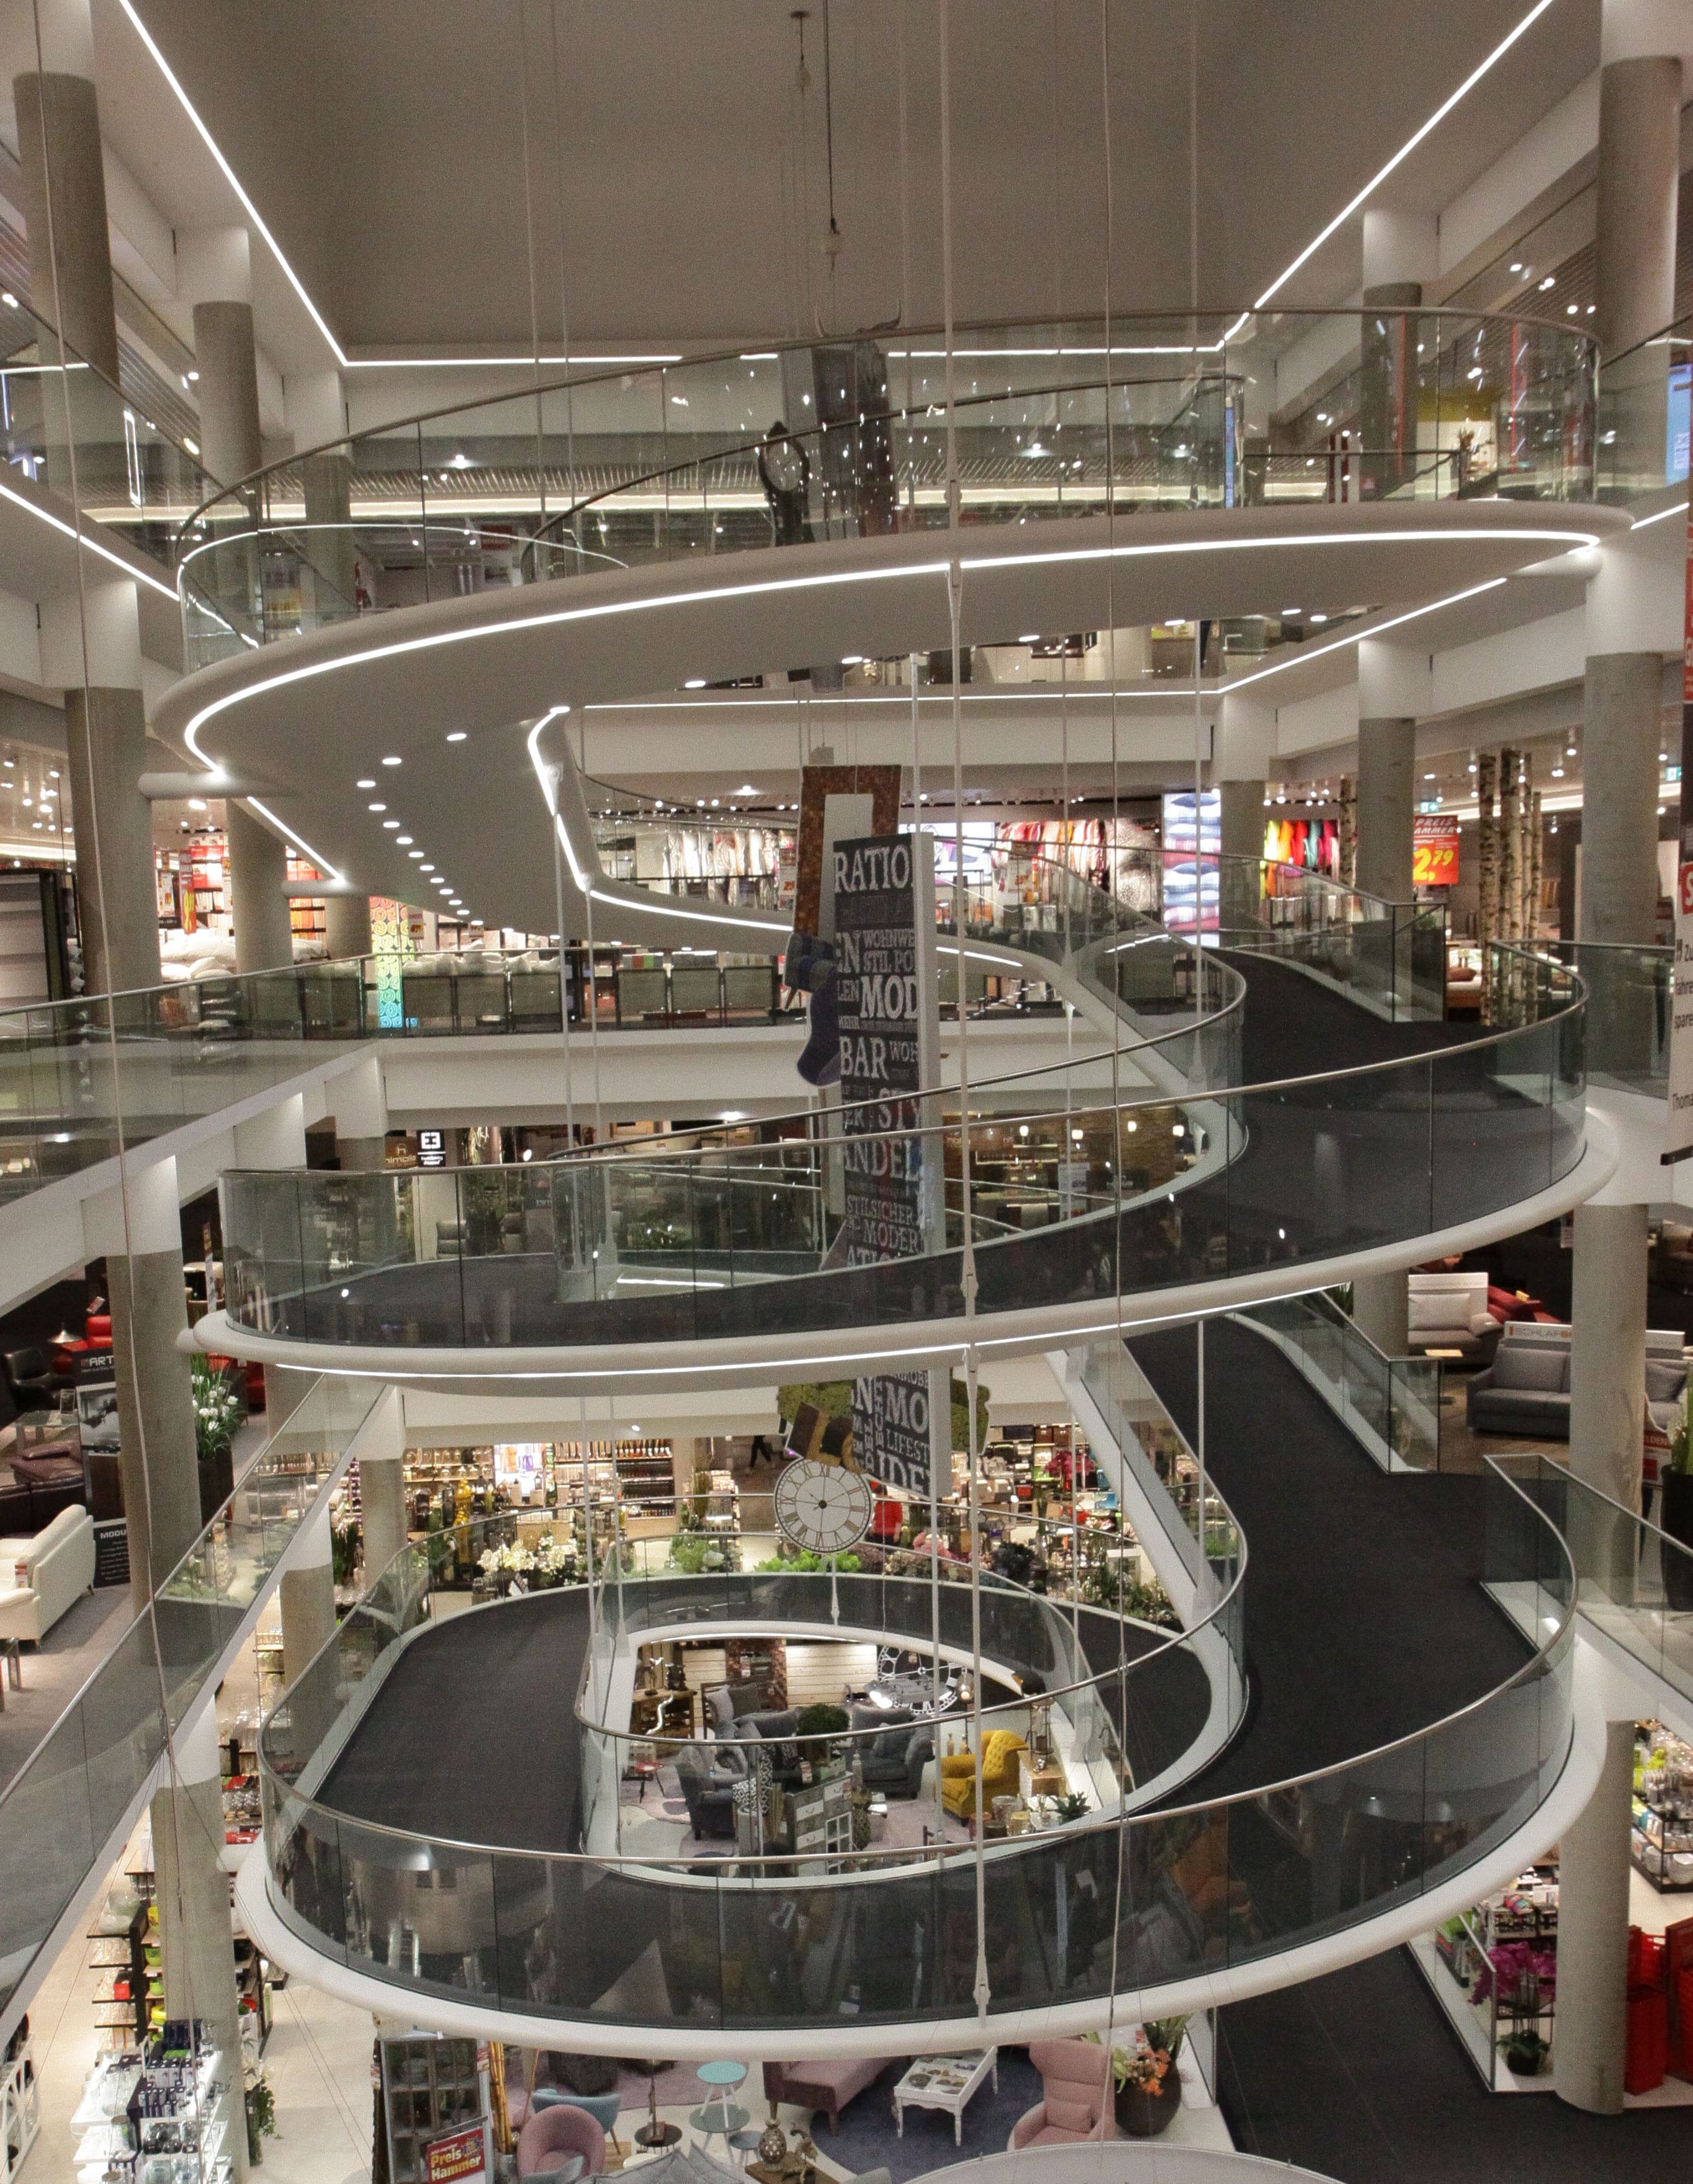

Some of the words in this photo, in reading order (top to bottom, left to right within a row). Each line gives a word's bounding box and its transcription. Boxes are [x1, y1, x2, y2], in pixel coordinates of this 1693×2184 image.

[839, 1036, 889, 1080] BAR
[431, 2146, 462, 2168] Preis
[431, 2155, 481, 2181] Hammer
